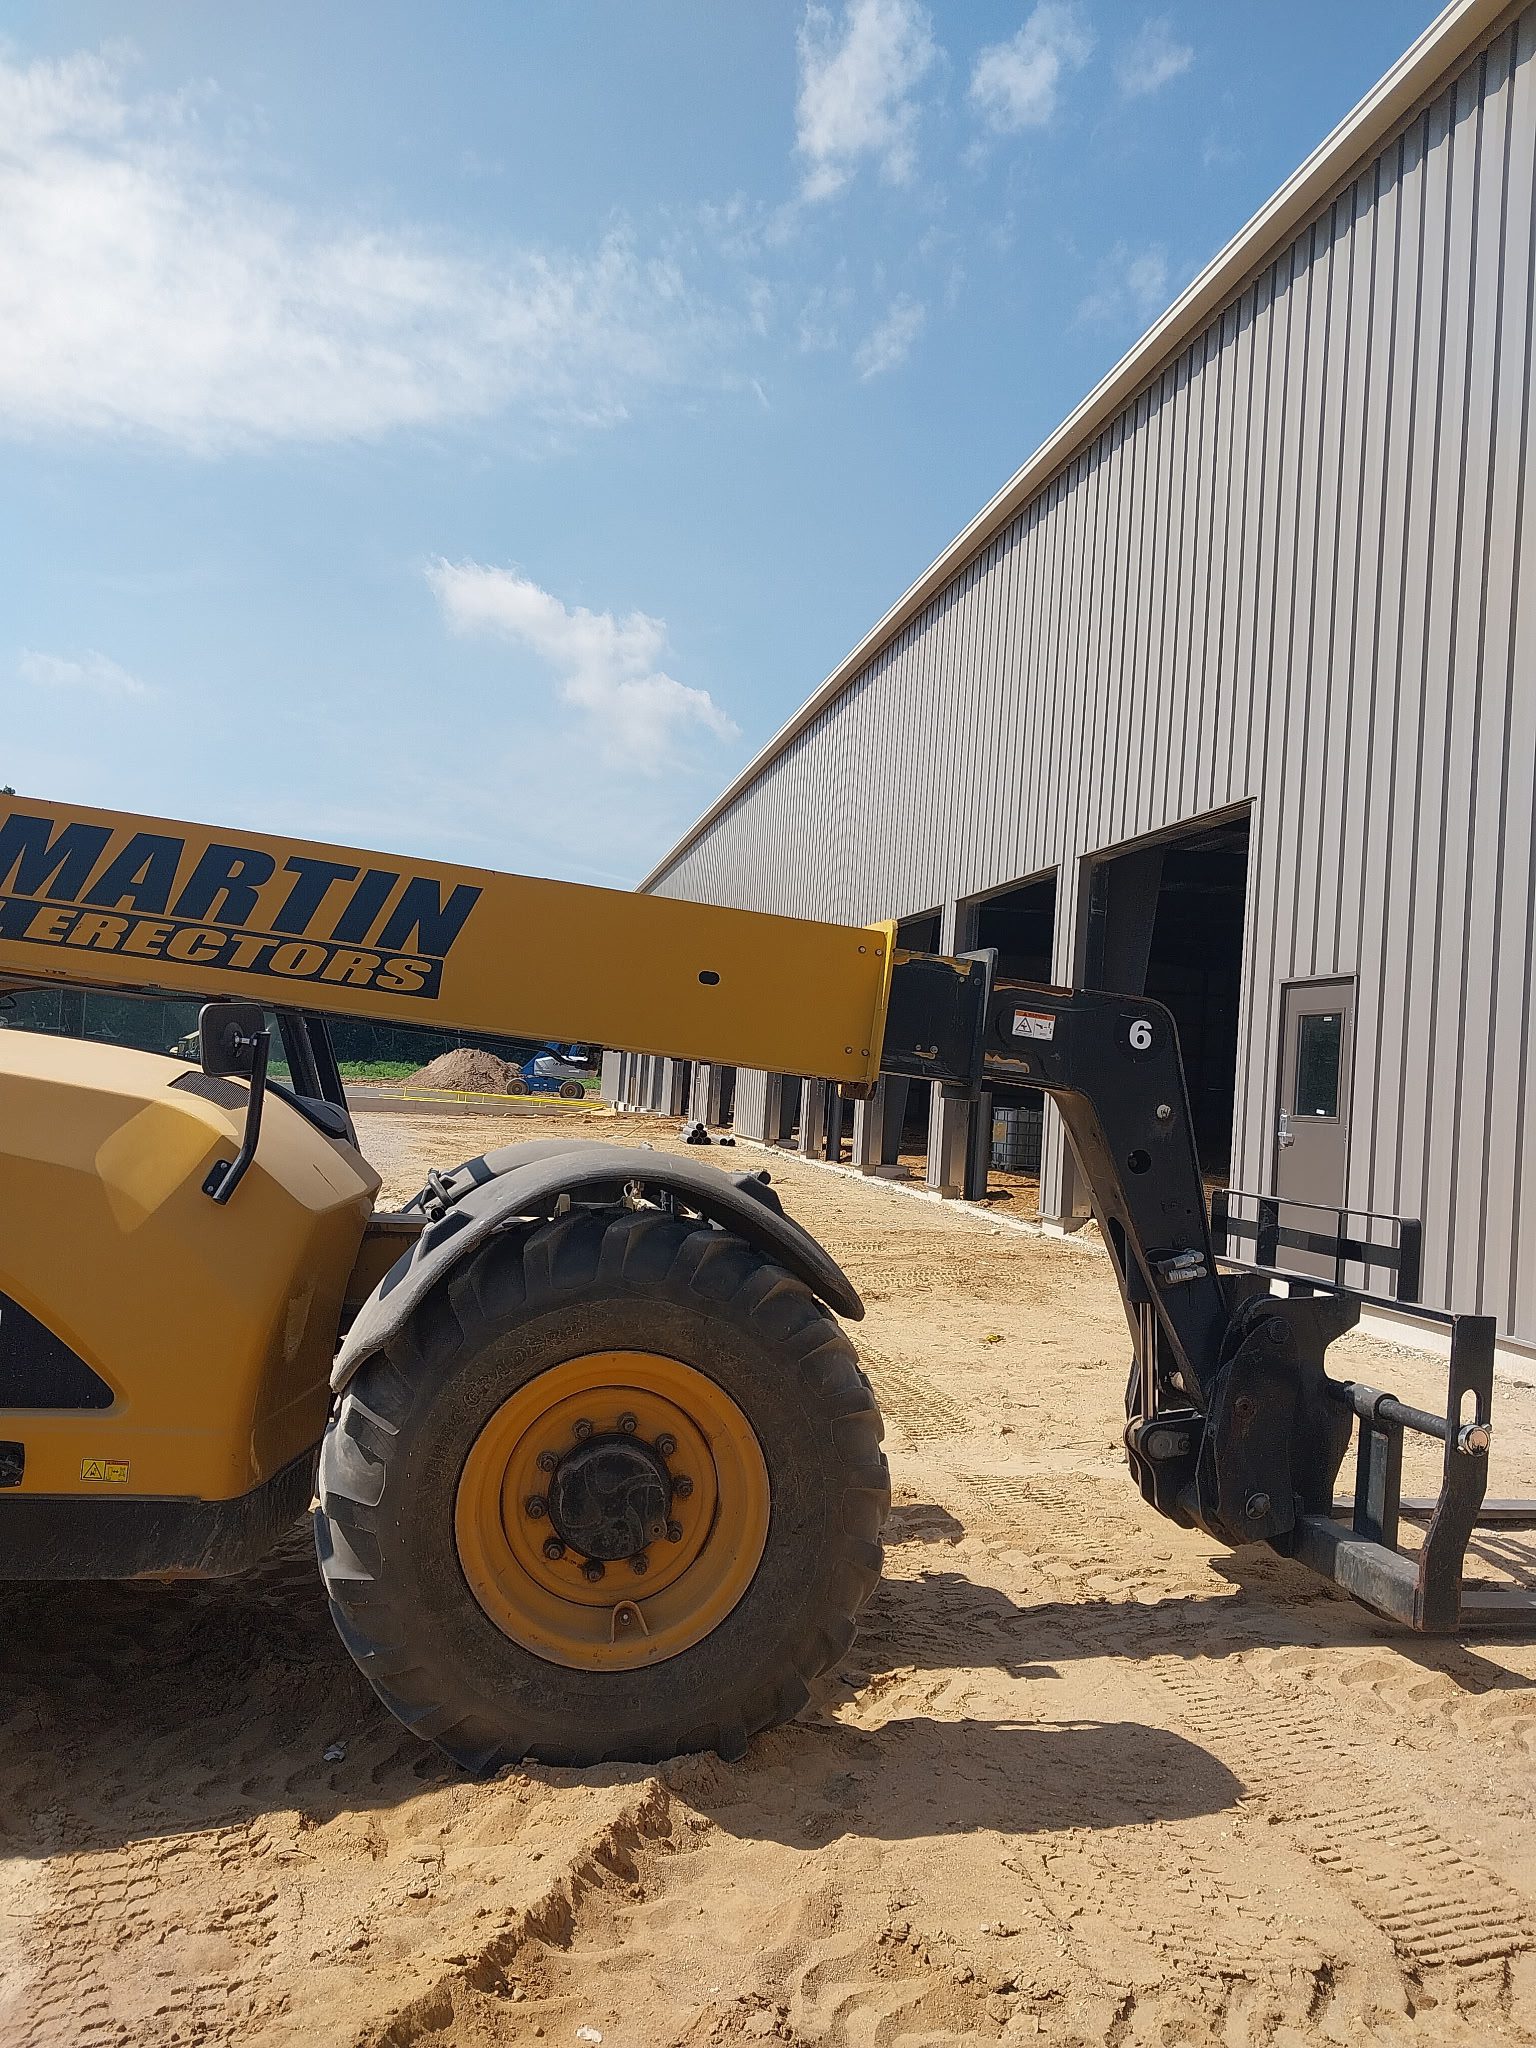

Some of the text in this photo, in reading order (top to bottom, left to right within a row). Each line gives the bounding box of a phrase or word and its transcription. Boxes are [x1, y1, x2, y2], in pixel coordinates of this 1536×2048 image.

[0, 814, 484, 958] MARTIN
[23, 906, 432, 991] ERECTORS
[1129, 1020, 1152, 1050] 6
